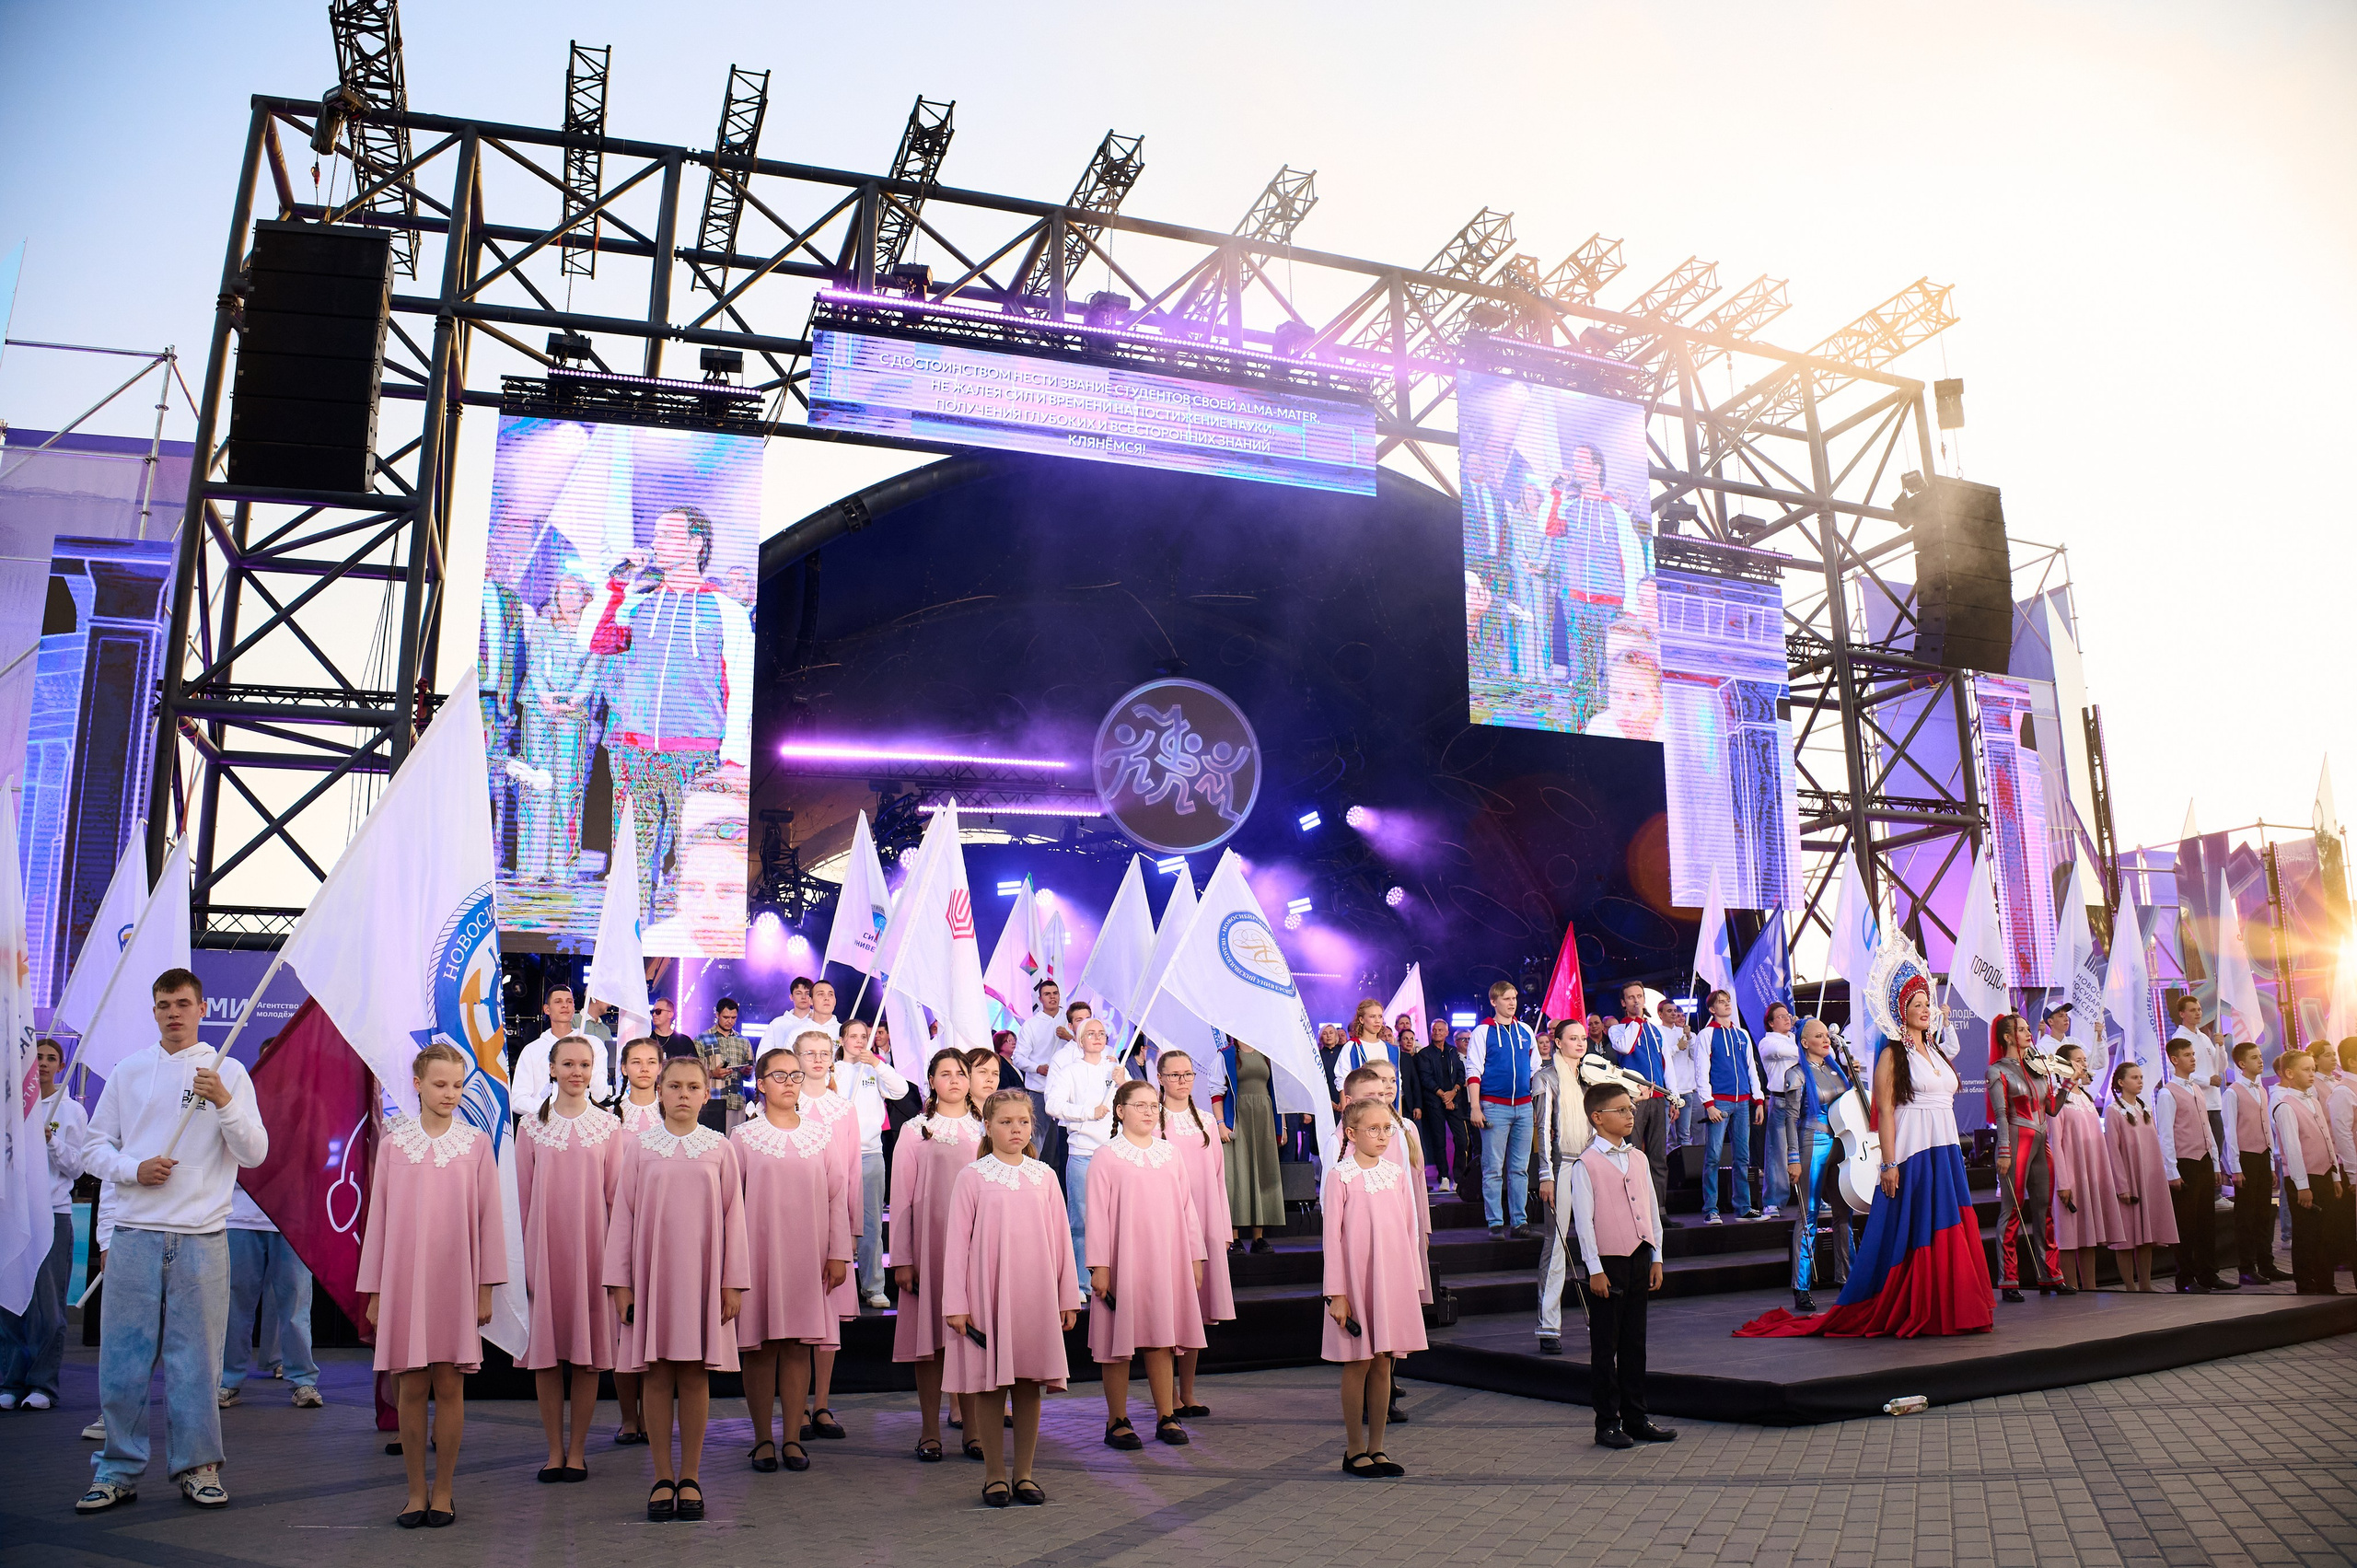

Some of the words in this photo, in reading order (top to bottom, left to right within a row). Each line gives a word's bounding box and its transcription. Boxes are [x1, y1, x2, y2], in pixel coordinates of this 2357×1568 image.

[879, 354, 890, 366] С
[890, 356, 1012, 381] ДОСТОИНСТВОМ
[1014, 371, 1059, 388] НЕСТИ
[1061, 377, 1112, 394] ЗВАНИЕ
[1115, 385, 1191, 405] СТУДЕНТОВ
[1193, 396, 1237, 412] СВОЕЙ
[1238, 402, 1321, 424] ALMA-MATER,
[931, 379, 949, 392] НЕ
[952, 382, 1002, 399] ЖАЛЕЯ
[1004, 388, 1035, 403] СИЛ
[1036, 392, 1047, 405] И
[1050, 394, 1113, 412] ВРЕМЕНИ
[1115, 401, 1134, 416] НА
[1135, 405, 1227, 429] ПОСТИЖЕНИЕ
[1229, 417, 1275, 437] НАУКИ,
[935, 399, 1022, 420] ПОЛУЧЕНИЯ
[1025, 410, 1097, 430] ГЛУБОКИХ
[1098, 420, 1109, 432] И
[1110, 421, 1216, 446] ВСЕСТОРОННИХ
[1218, 436, 1271, 452] ЗНАНИЙ
[1068, 434, 1147, 455] КЛЯНЁМСЯ!
[2075, 972, 2102, 1000] НОВОС
[202, 997, 250, 1019] МИ
[256, 1001, 299, 1011] Агентство
